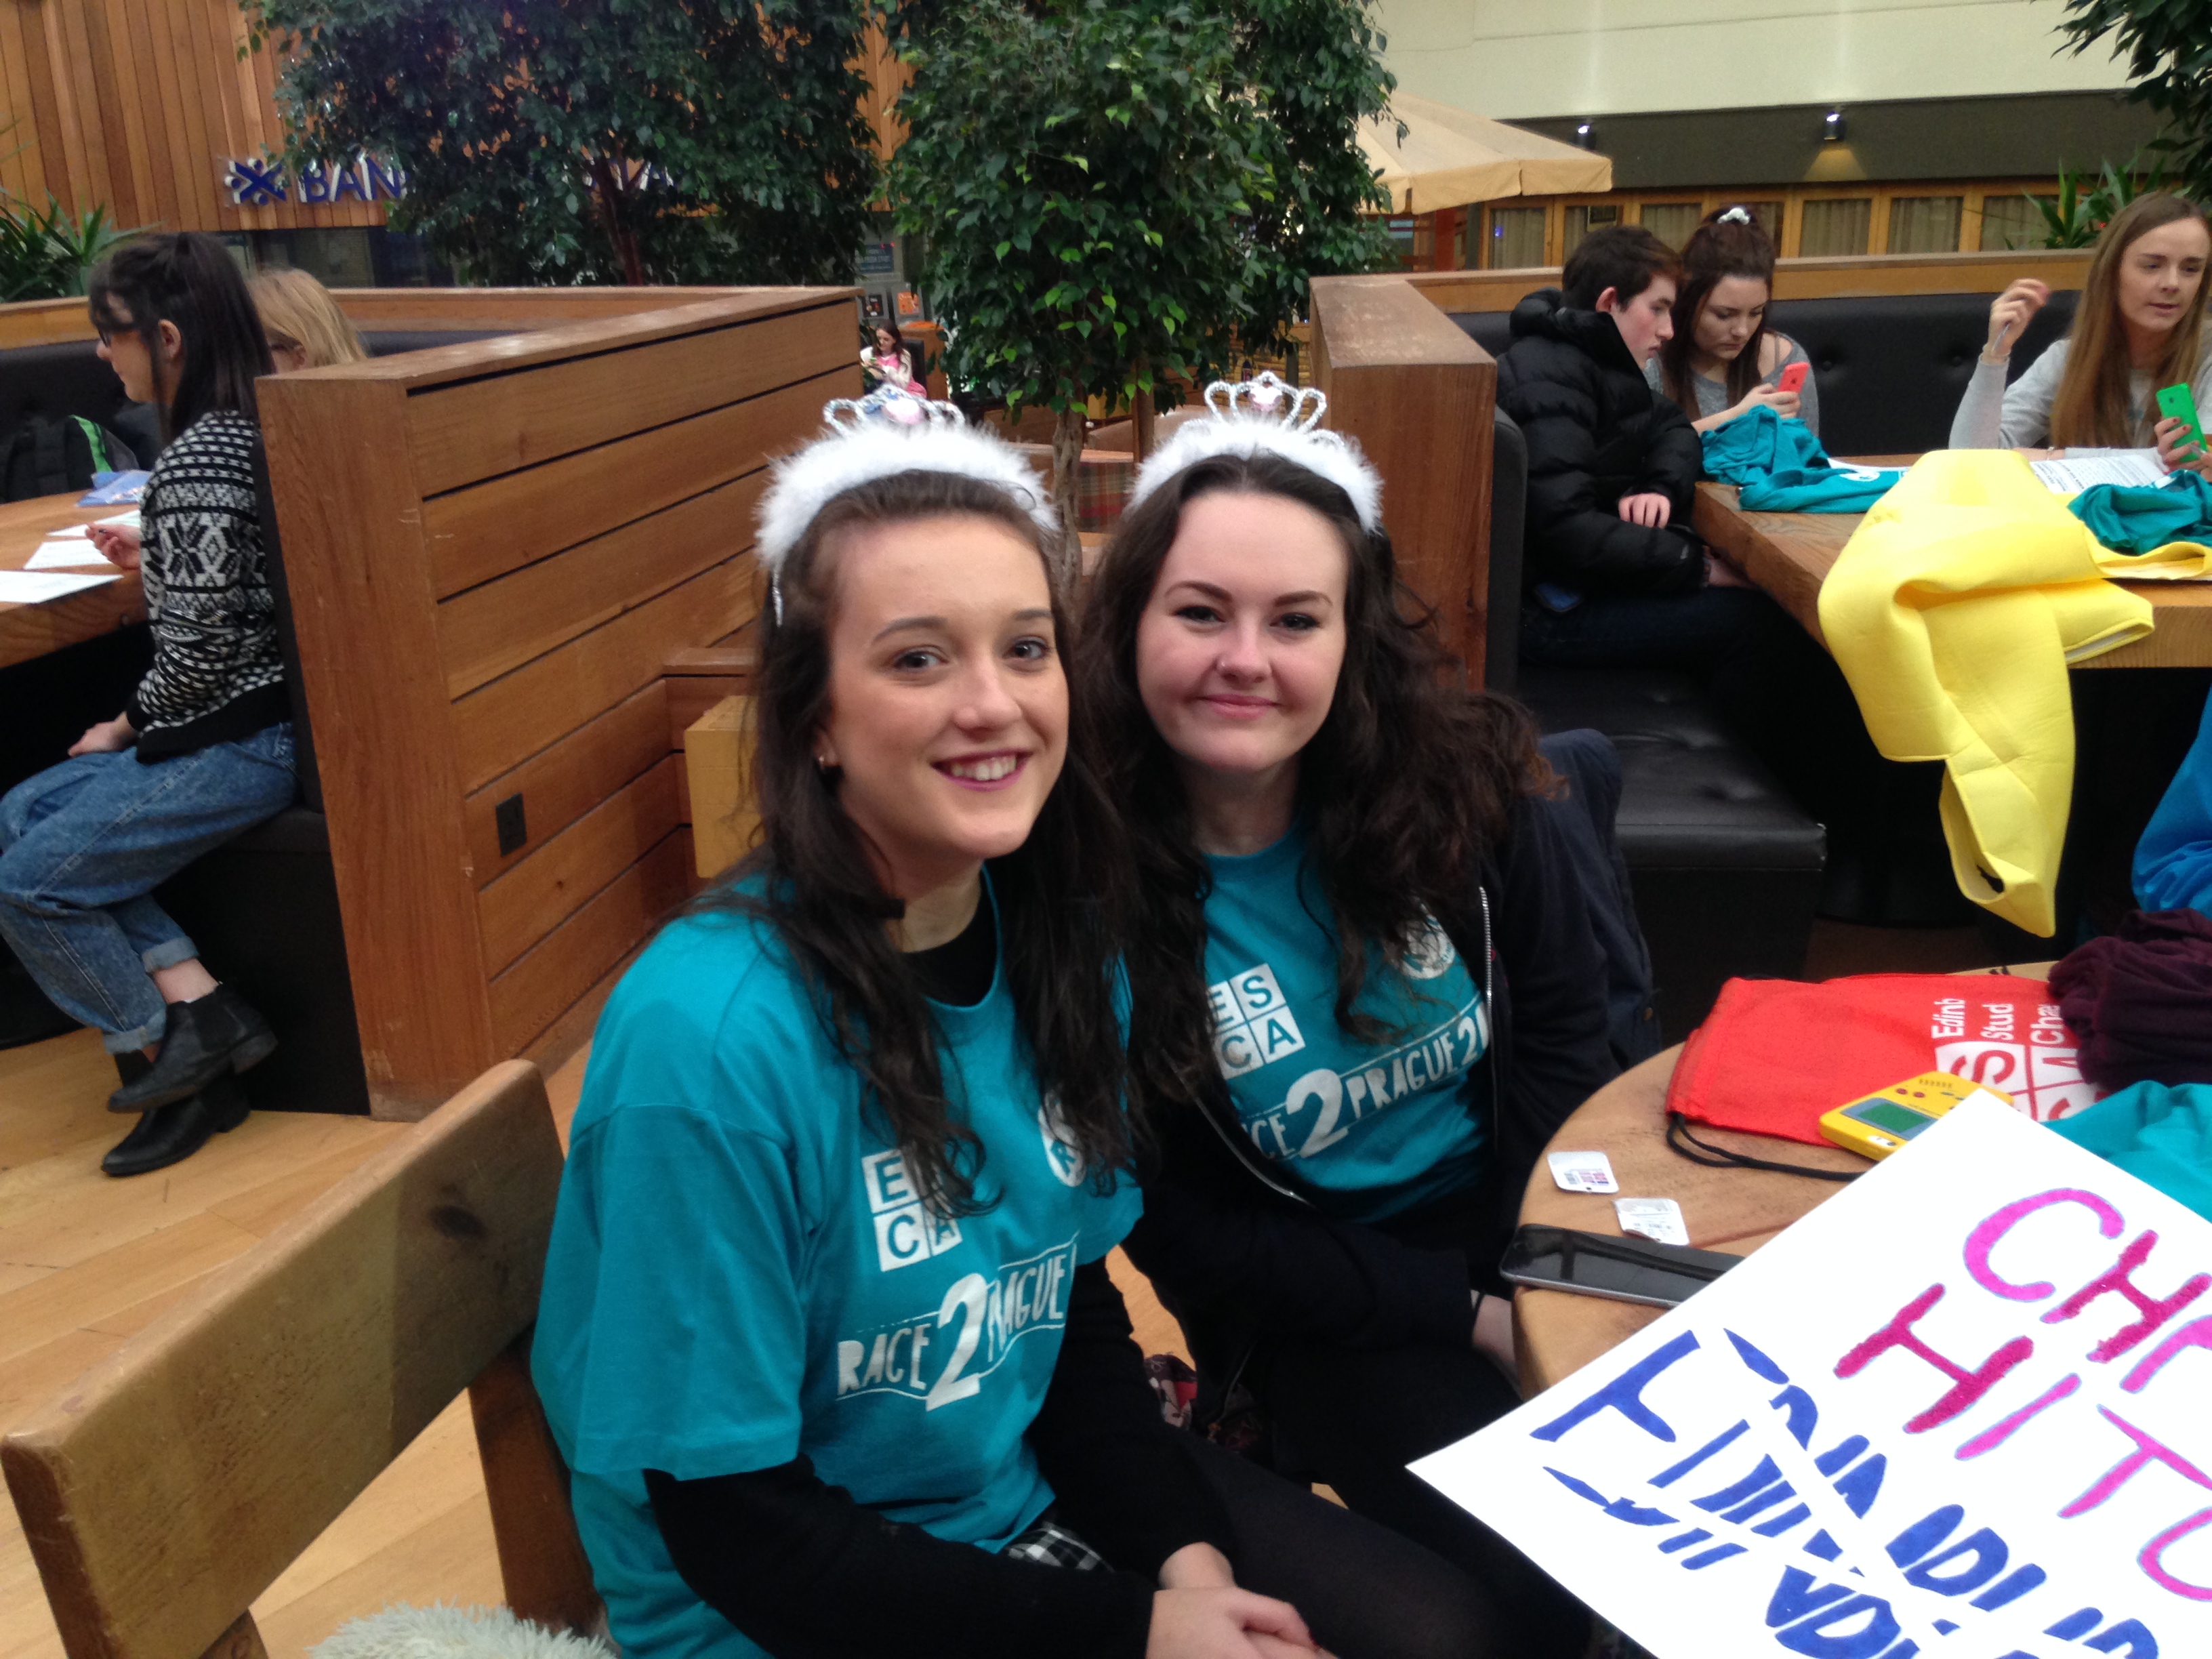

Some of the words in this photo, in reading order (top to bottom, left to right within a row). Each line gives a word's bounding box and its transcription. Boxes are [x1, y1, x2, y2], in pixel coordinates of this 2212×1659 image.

[298, 152, 405, 203] BAN
[1931, 998, 1966, 1039] Edinb
[1980, 1002, 2014, 1041] Stud
[1286, 1068, 1349, 1160] 2
[1345, 1031, 1460, 1120] PRAGUE
[837, 1322, 932, 1396] RACE
[925, 1271, 989, 1412] 2
